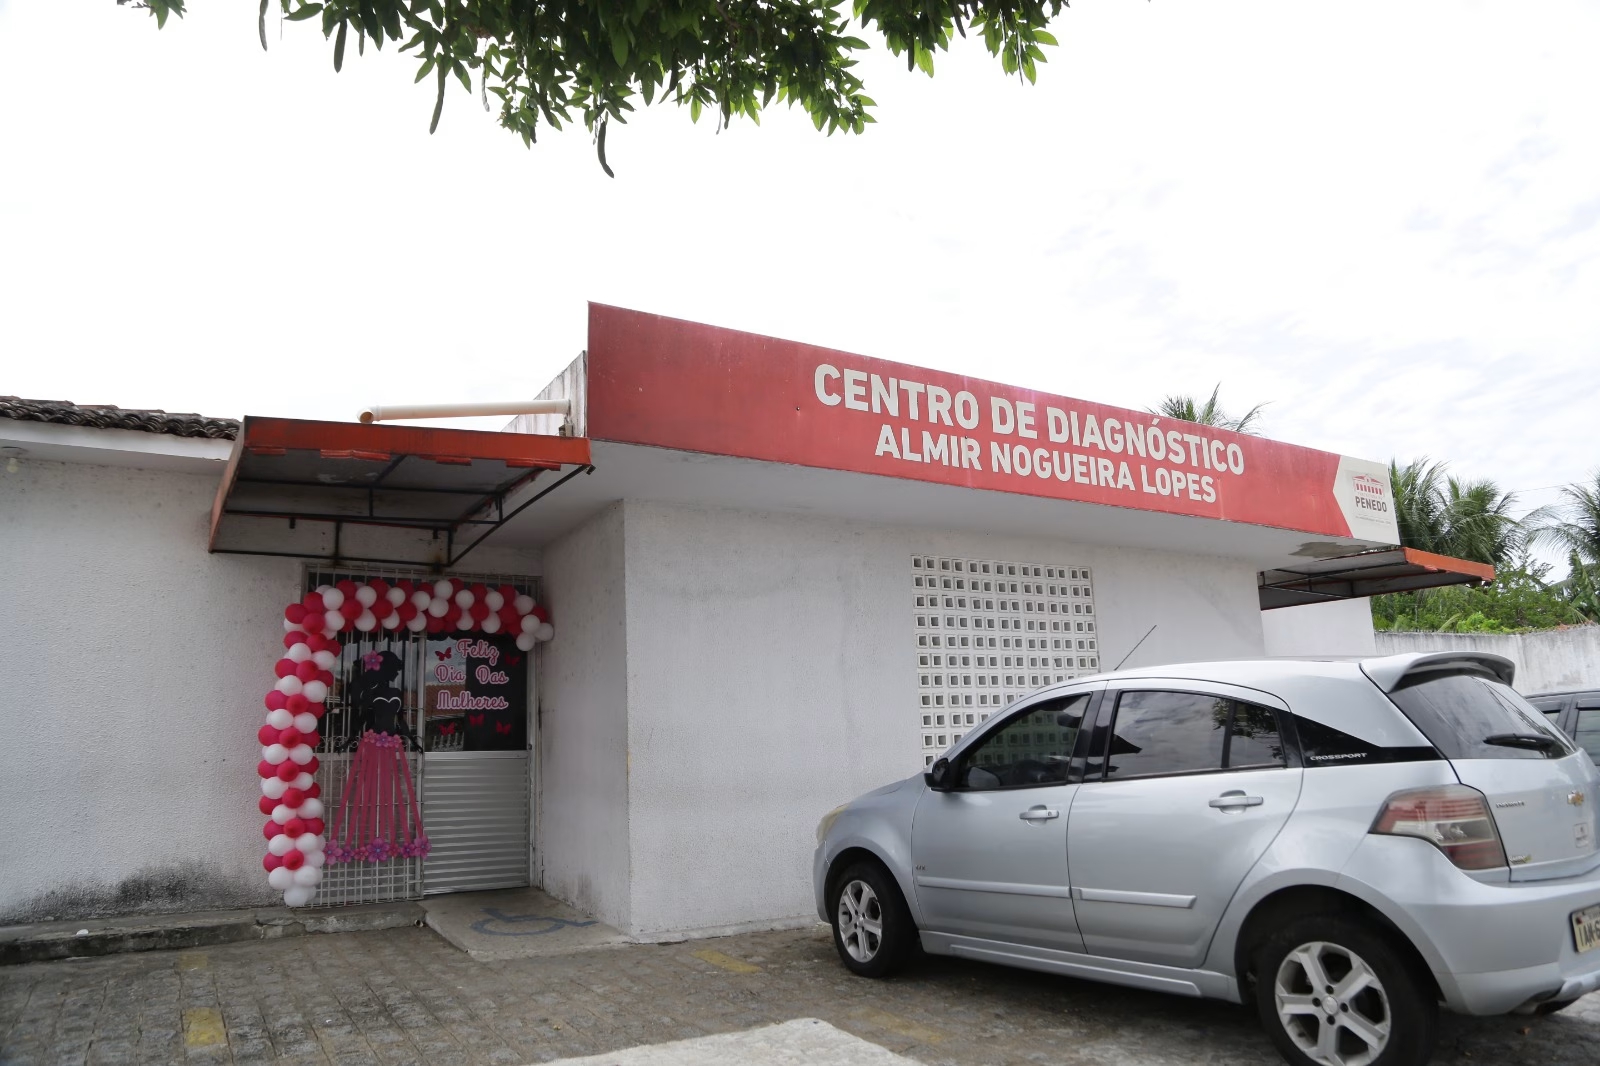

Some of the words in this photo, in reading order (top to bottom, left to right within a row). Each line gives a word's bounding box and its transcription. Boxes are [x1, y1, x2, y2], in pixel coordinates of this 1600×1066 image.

[814, 363, 980, 430] CENTRO
[990, 396, 1039, 439] DE
[1047, 406, 1245, 476] DIAGNÓSTICO
[875, 424, 982, 471] ALMIR
[991, 441, 1136, 491] NOGUEIRA
[1140, 464, 1217, 504] LOPES
[1355, 496, 1388, 513] PENEDO
[456, 638, 500, 666] Feliz
[435, 664, 466, 683] Dia
[475, 665, 509, 684] Das
[437, 690, 509, 710] Mulheres
[1310, 752, 1368, 761] CROSSPORT
